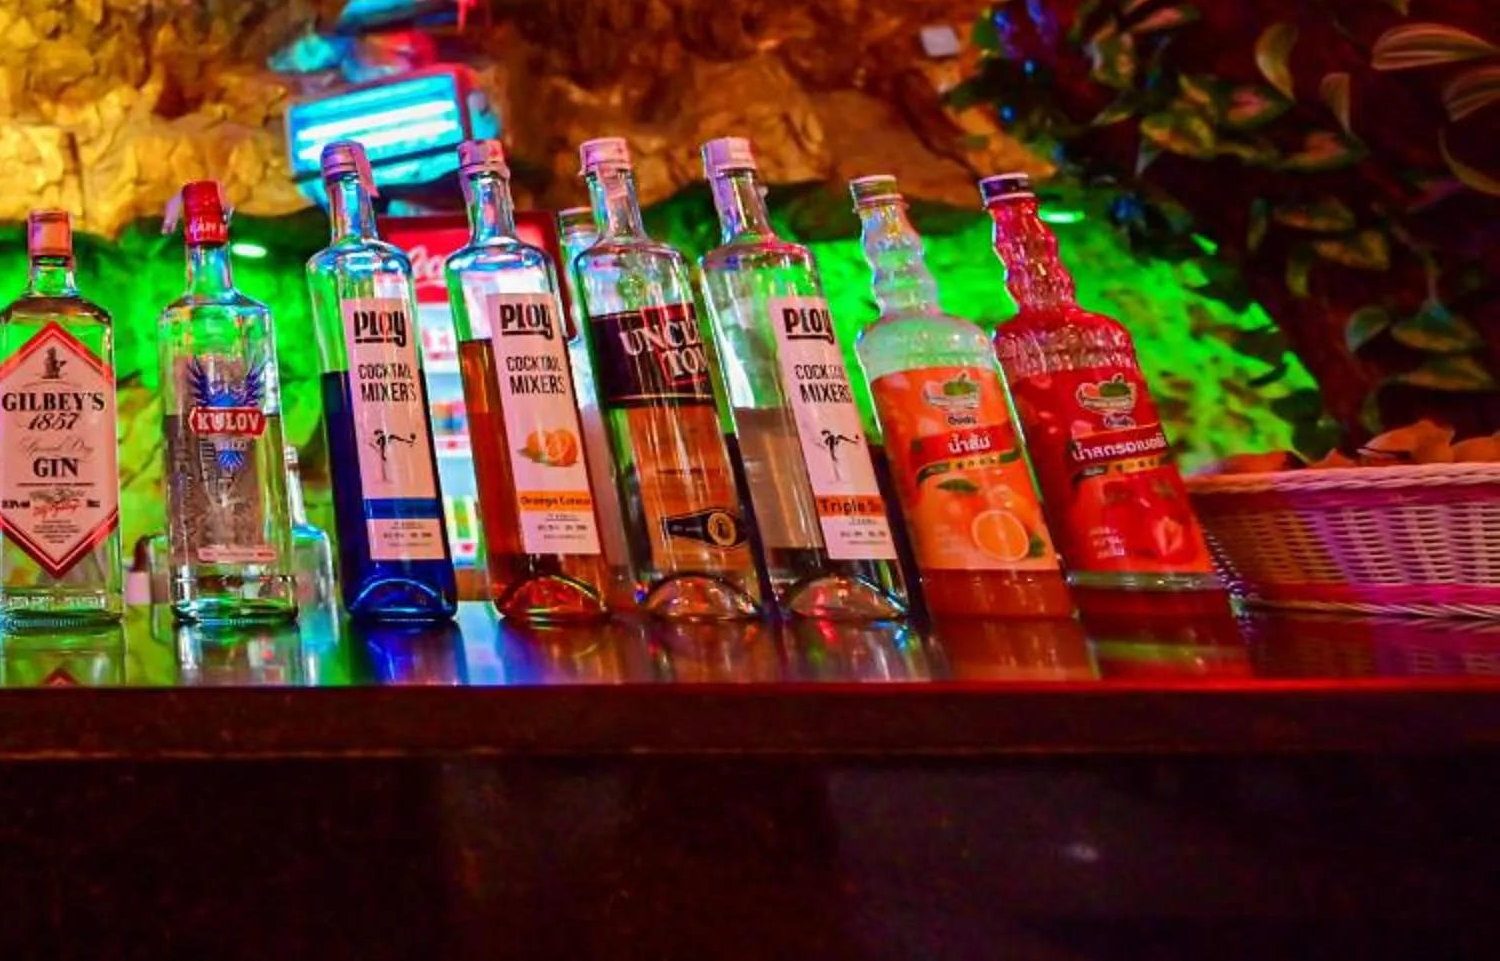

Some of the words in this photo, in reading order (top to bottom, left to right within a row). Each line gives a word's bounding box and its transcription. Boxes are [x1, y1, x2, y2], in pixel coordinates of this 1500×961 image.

[360, 382, 417, 402] MIXERS
[509, 374, 566, 395] MIXERS
[1, 392, 105, 412] GILBEY'S
[27, 412, 80, 431] 1857
[197, 412, 260, 431] KULOV
[33, 457, 78, 477] GIN
